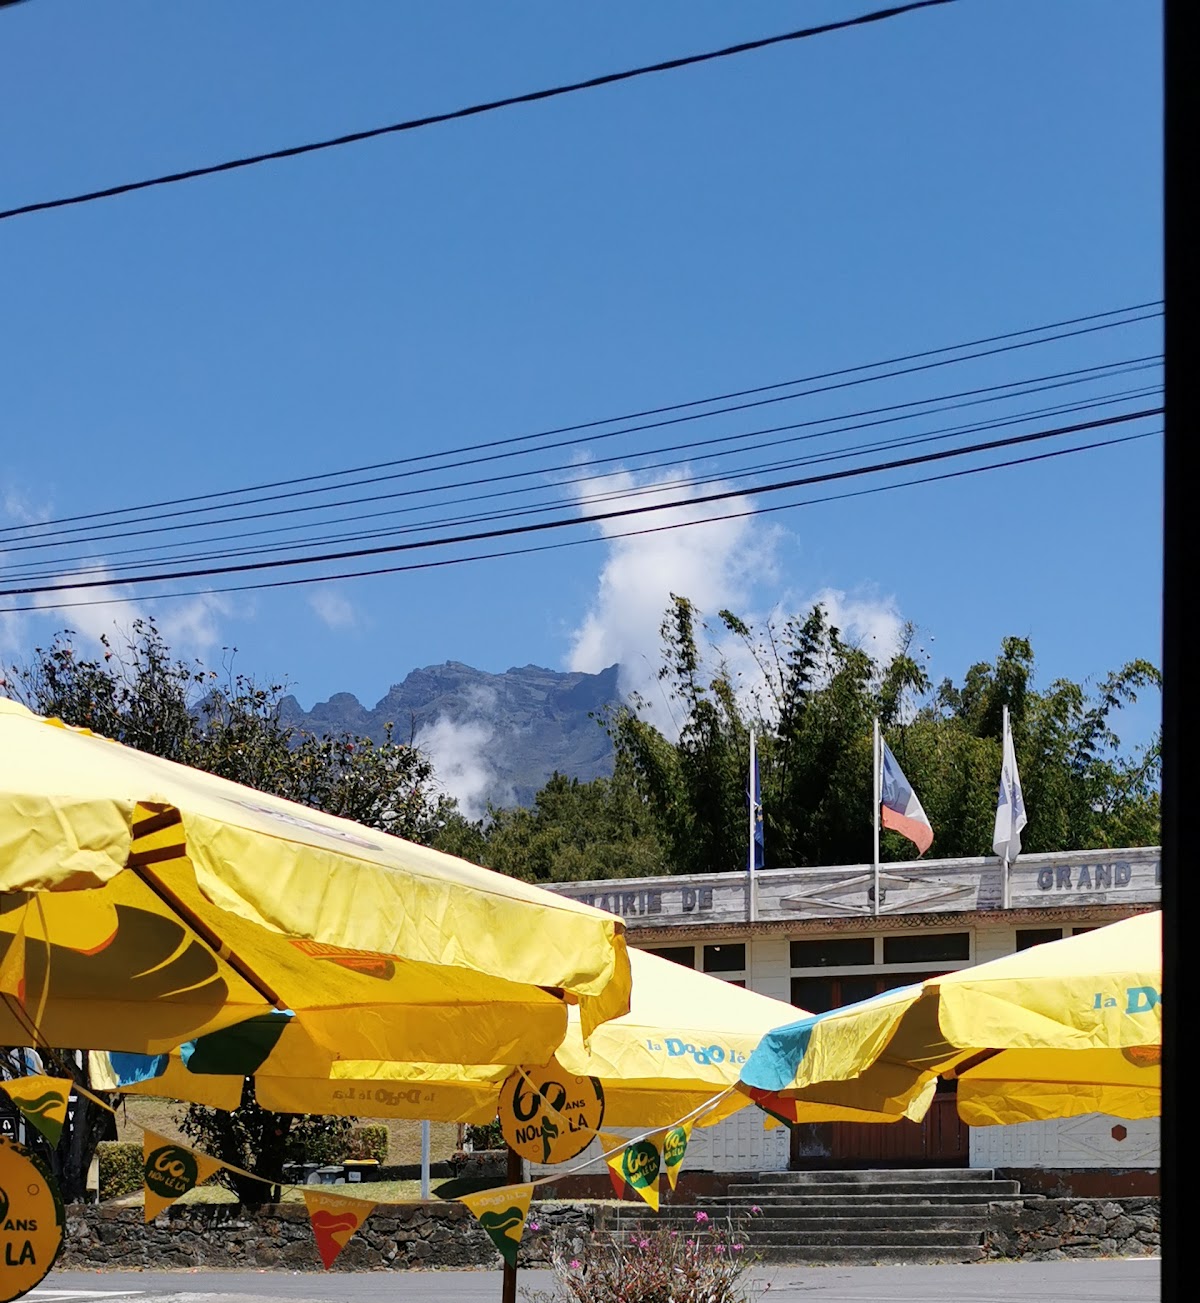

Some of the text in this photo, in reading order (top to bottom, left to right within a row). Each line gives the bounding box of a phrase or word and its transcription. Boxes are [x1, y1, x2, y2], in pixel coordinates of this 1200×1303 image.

[1037, 861, 1132, 891] GRAND
[682, 886, 712, 912] DE
[1093, 992, 1117, 1009] la
[646, 1039, 662, 1051] la
[565, 1099, 586, 1111] ANS
[155, 1149, 186, 1177] 60
[627, 1149, 649, 1174] 60
[3, 1219, 38, 1231] ANS
[5, 1240, 36, 1266] LA
